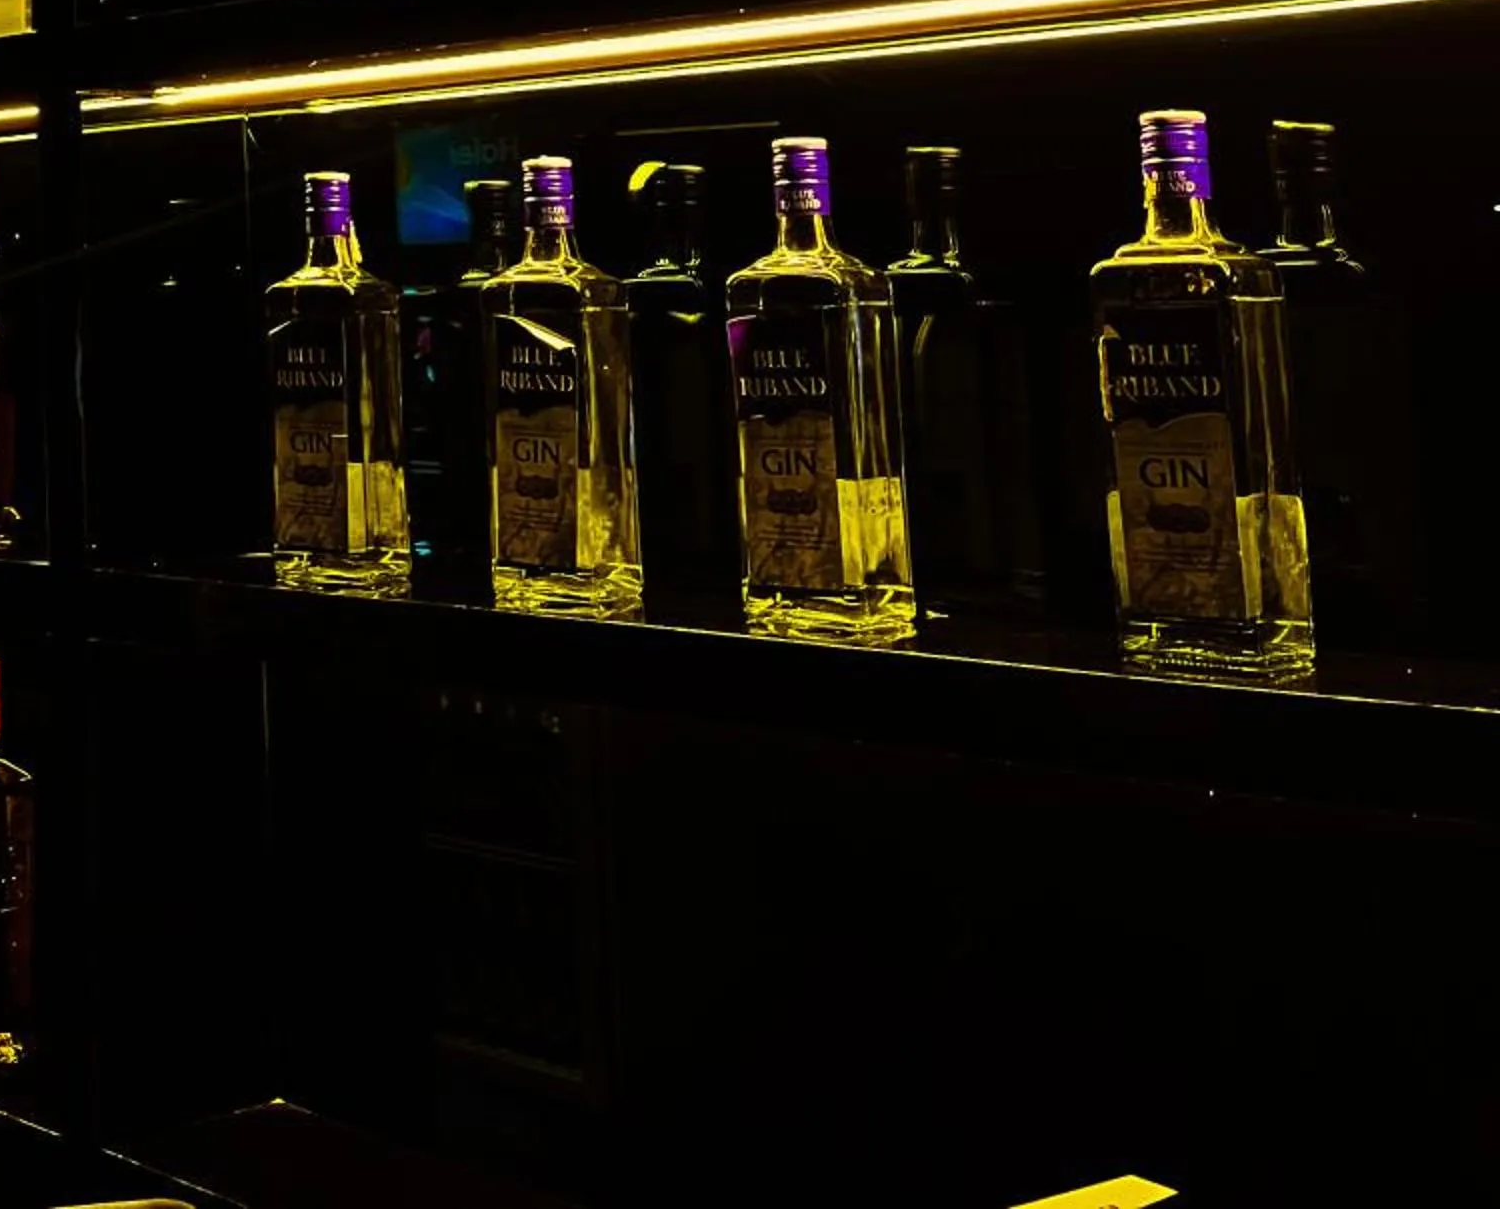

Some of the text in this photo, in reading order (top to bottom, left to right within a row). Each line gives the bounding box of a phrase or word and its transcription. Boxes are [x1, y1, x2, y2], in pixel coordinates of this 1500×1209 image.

[511, 344, 563, 367] BLUE
[752, 348, 812, 369] BLUE
[1128, 342, 1203, 367] BLUE
[276, 368, 344, 389] RIBAND
[500, 368, 575, 393] RIBAND
[738, 375, 828, 398] RIBAND
[1113, 374, 1222, 404] RIBAND
[289, 431, 333, 455] GIN
[512, 438, 561, 464] GIN
[761, 448, 817, 476] GIN
[1139, 457, 1210, 489] GIN
